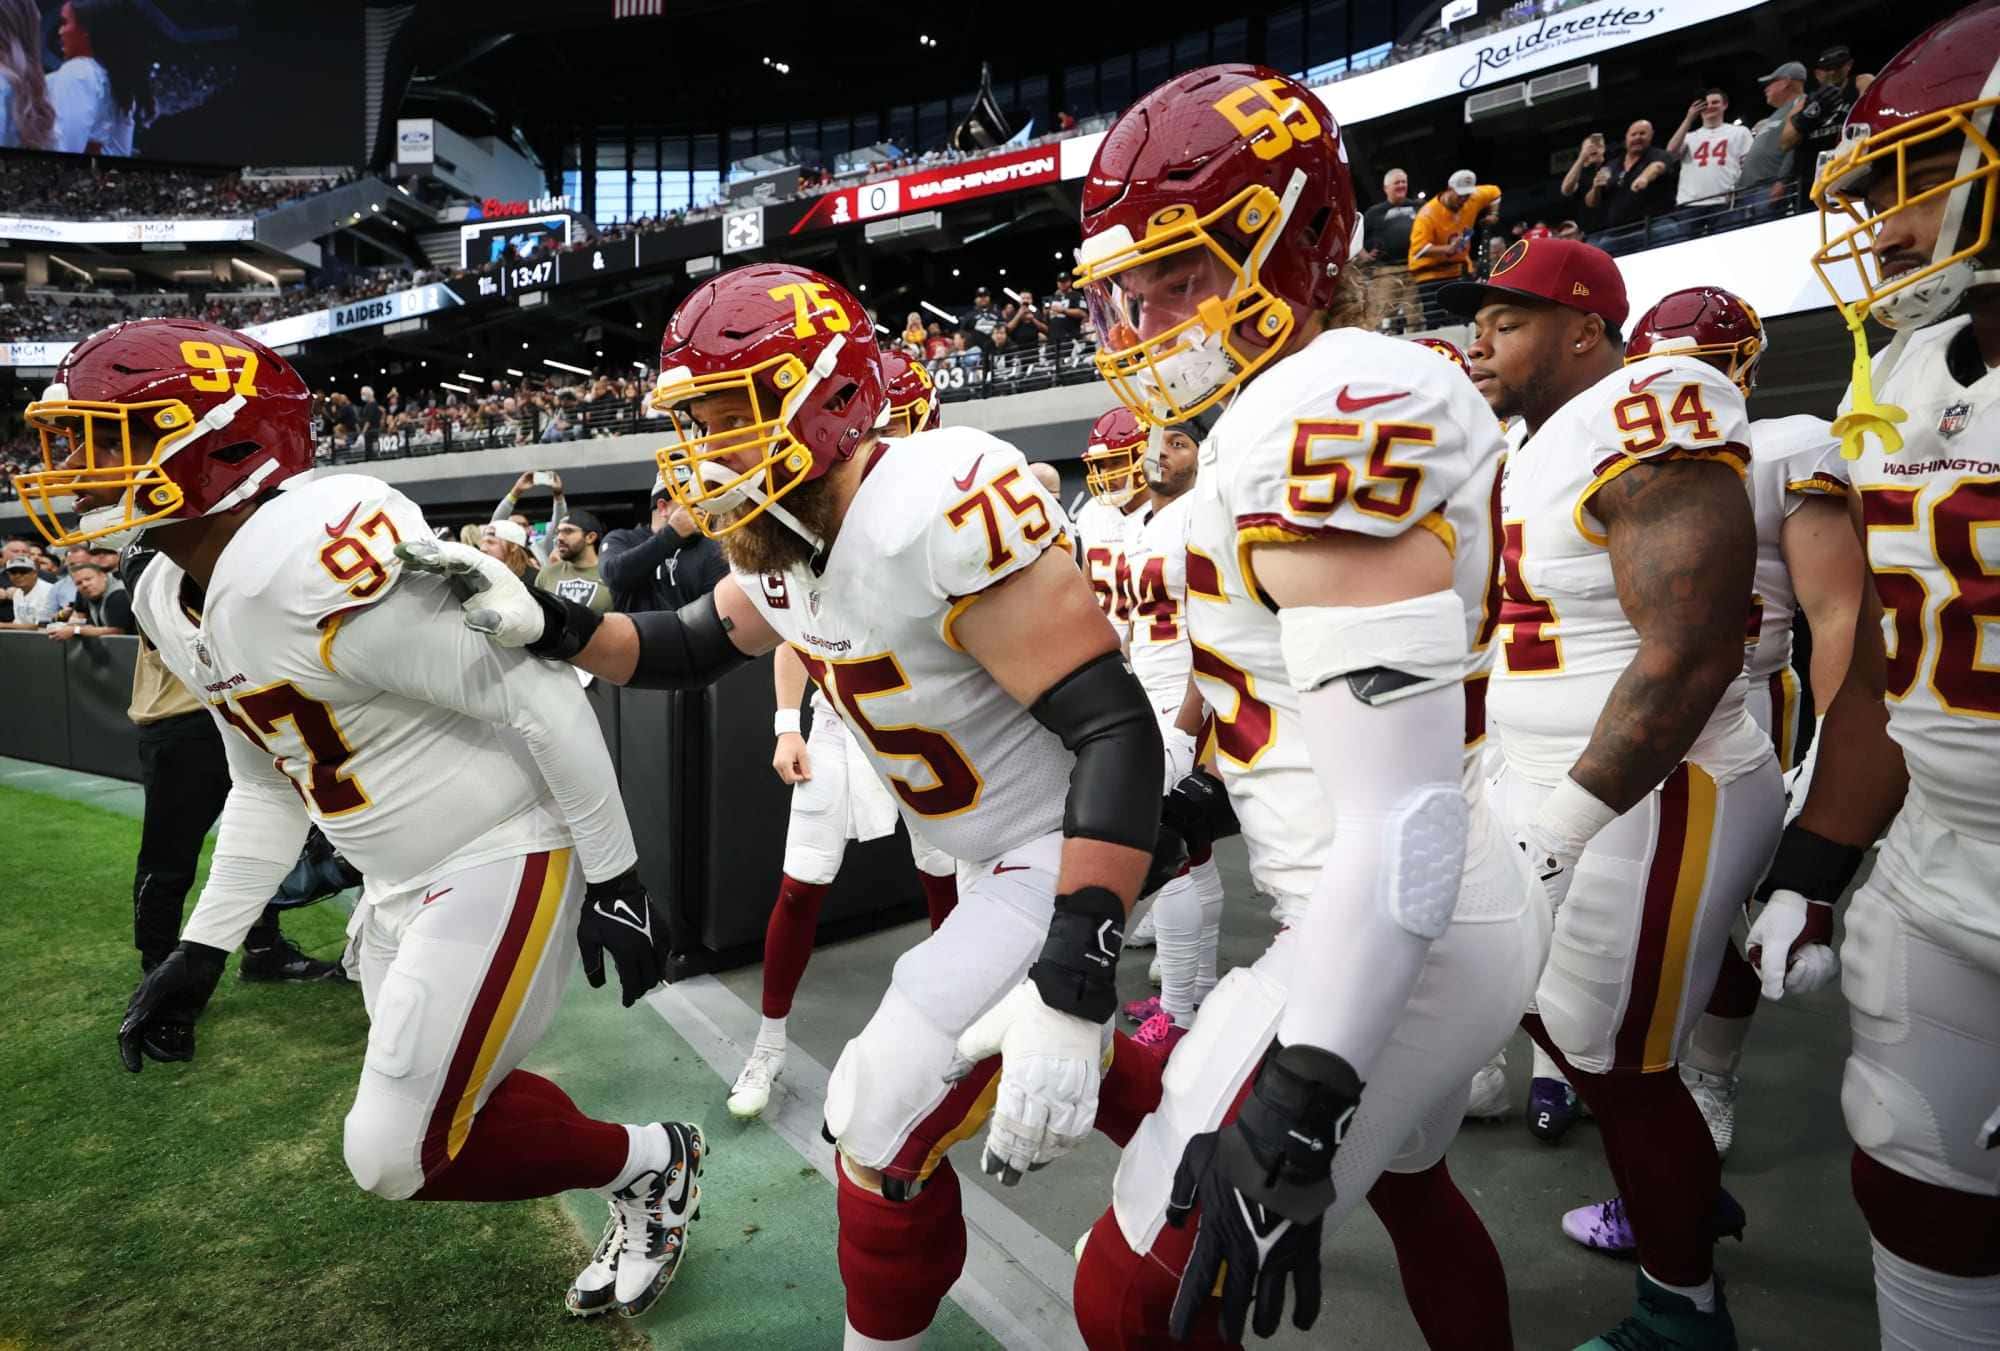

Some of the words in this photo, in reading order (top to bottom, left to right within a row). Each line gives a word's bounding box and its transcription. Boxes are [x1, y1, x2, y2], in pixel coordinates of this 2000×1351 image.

[1459, 7, 1658, 88] Raiderettes
[1212, 79, 1321, 160] 55
[1694, 138, 1729, 167] 44
[910, 156, 1055, 199] WASHINGTON
[528, 195, 571, 213] LIGHT
[871, 187, 886, 211] 0
[510, 261, 552, 289] 13:47
[592, 251, 605, 270] &
[336, 301, 393, 327] RAIDERS
[767, 282, 850, 340] 75
[180, 340, 259, 397] 97
[1613, 381, 1721, 454] 94
[377, 435, 399, 452] 102
[1287, 418, 1437, 523] 55
[944, 464, 1051, 576] 75
[318, 508, 402, 597] 97
[761, 573, 785, 598] C
[1537, 1111, 1550, 1128] 2
